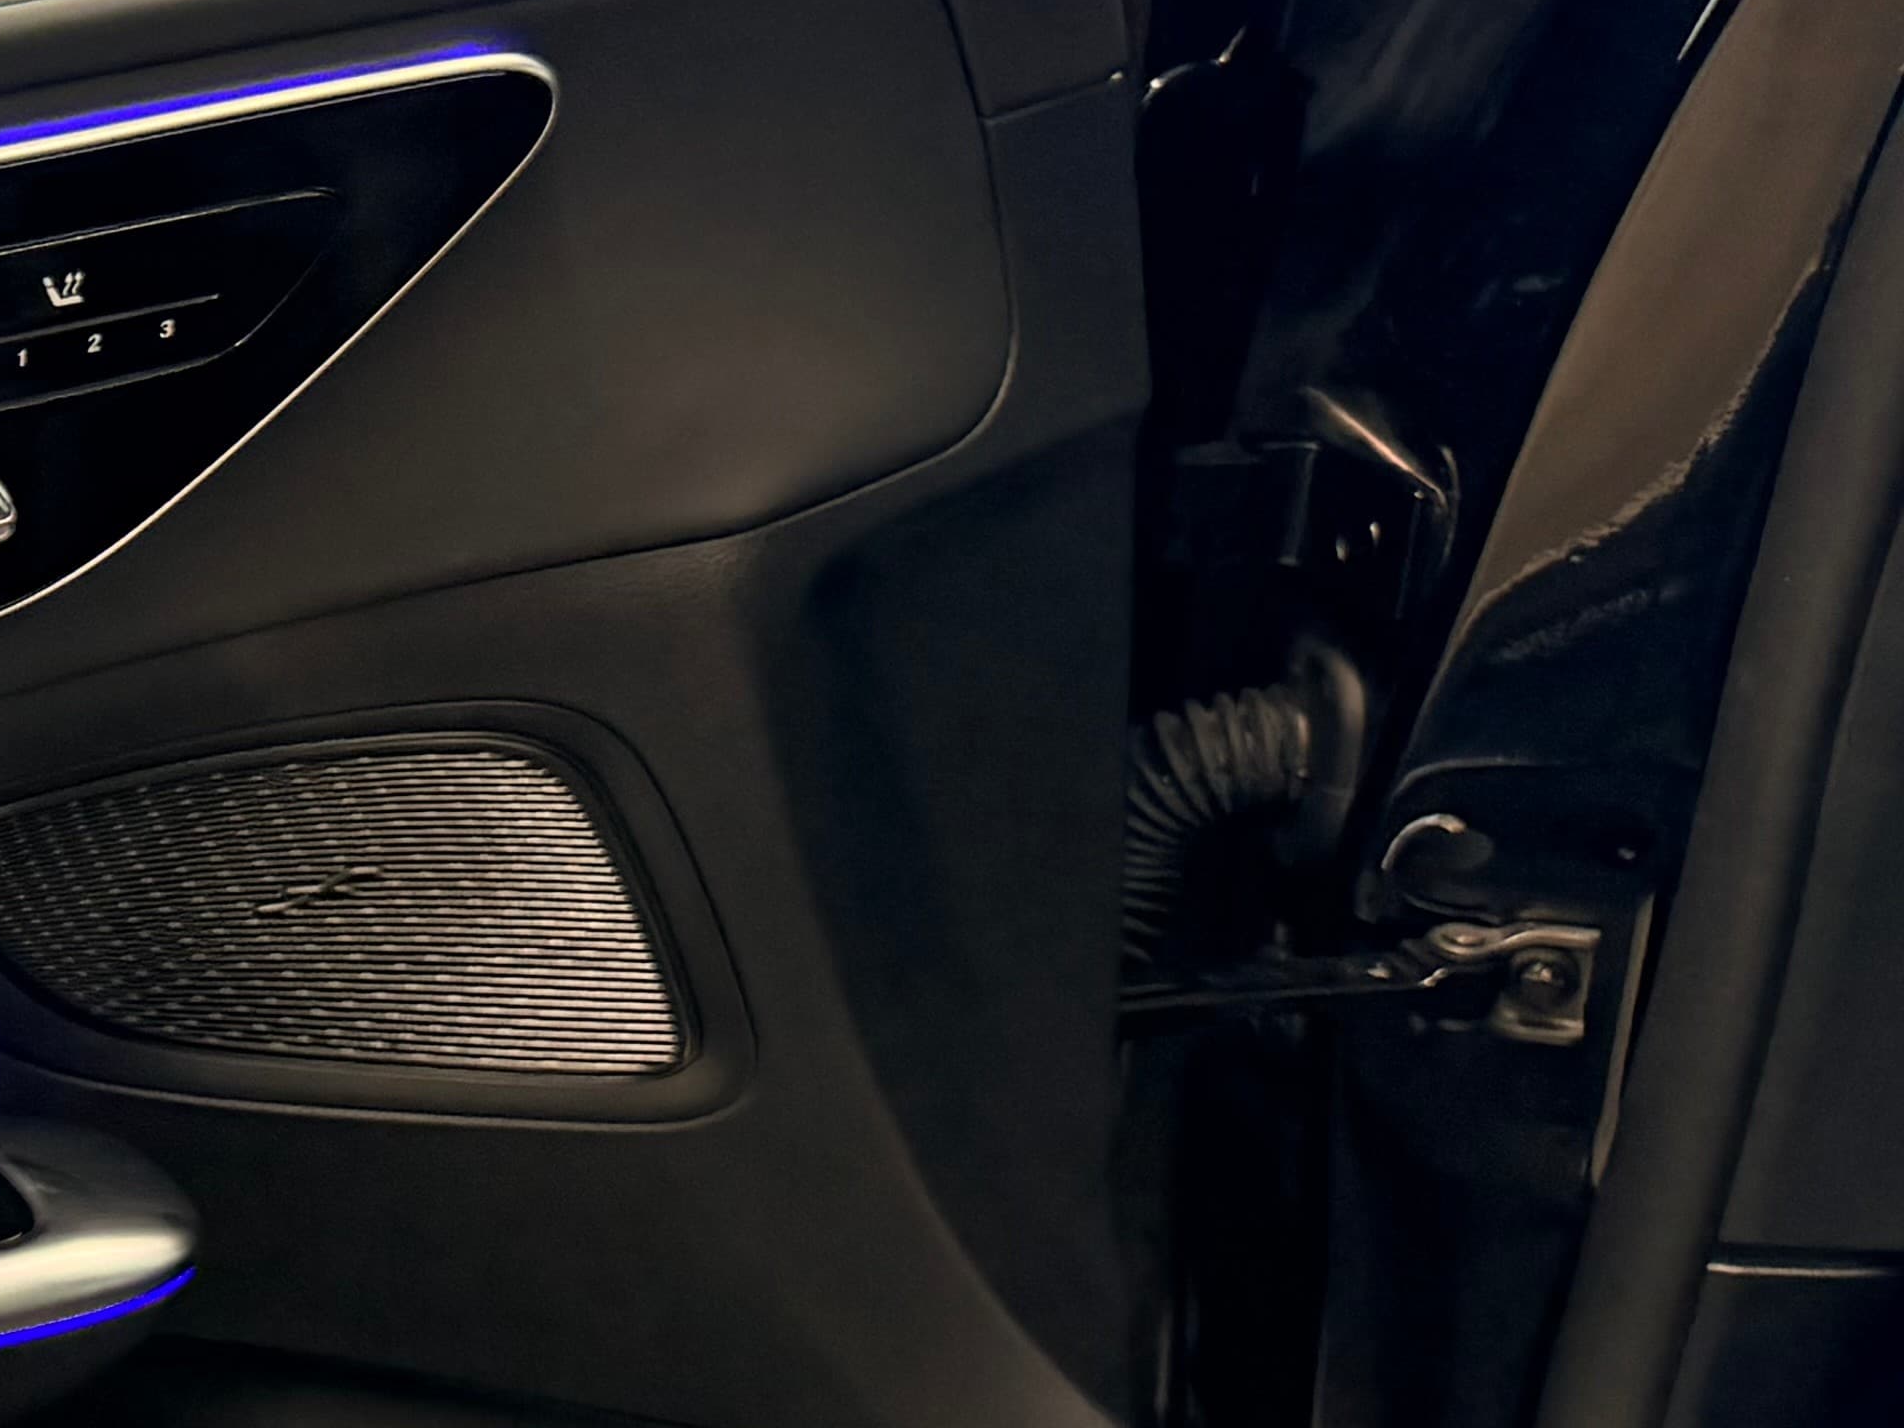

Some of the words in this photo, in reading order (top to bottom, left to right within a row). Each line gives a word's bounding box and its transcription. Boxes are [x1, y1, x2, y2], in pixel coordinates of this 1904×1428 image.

[17, 348, 28, 367] 1
[87, 333, 103, 353] 2
[159, 319, 176, 339] 3
